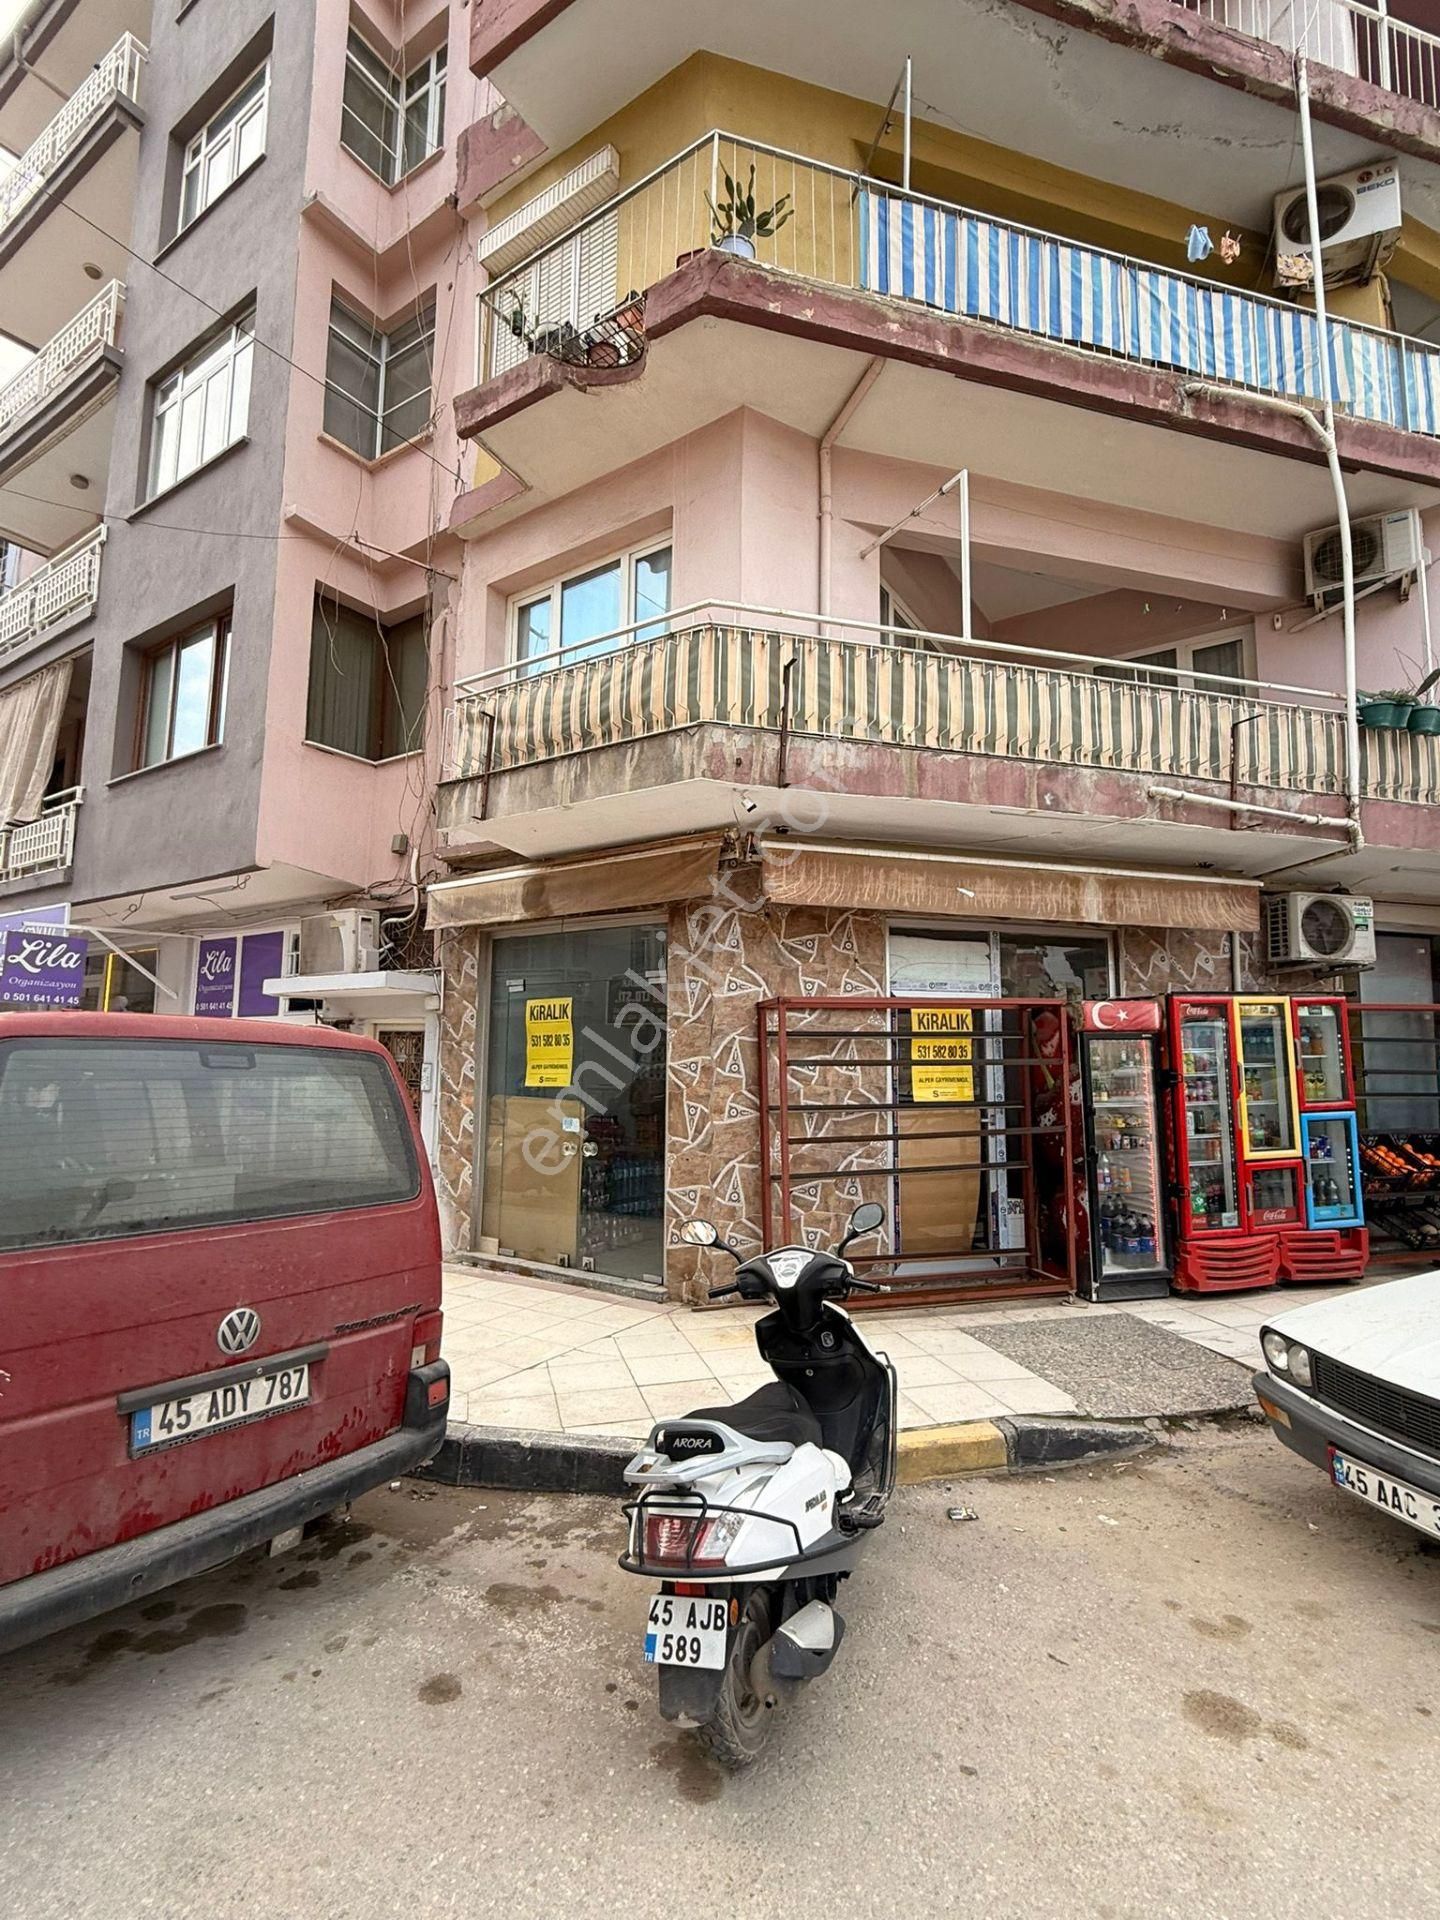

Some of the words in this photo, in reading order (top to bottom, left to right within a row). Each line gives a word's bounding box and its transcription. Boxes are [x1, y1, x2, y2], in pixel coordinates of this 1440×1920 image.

[1377, 166, 1392, 177] LG
[1357, 177, 1395, 194] BEKO
[8, 939, 81, 973] Lila
[200, 950, 232, 980] Lila
[9, 976, 77, 990] Organizasyon
[3, 992, 10, 1000] 0
[13, 992, 30, 1001] 501
[34, 994, 50, 1002] 641
[54, 995, 65, 1003] 41
[67, 996, 80, 1004] 45
[531, 1035, 541, 1047] 531
[543, 1035, 553, 1047] 582
[554, 1034, 561, 1046] 80
[562, 1034, 570, 1046] 35
[918, 1046, 931, 1058] 531
[933, 1046, 946, 1058] 582
[948, 1046, 957, 1058] 80
[958, 1046, 968, 1058] 35
[159, 1398, 191, 1434] 45
[207, 1381, 251, 1422] ADY
[265, 1367, 305, 1405] 787
[137, 1428, 150, 1440] TR
[673, 1437, 712, 1449] ARORA
[1345, 1466, 1368, 1495] 45
[1377, 1479, 1417, 1519] AAC
[649, 1600, 674, 1626] 45
[686, 1602, 726, 1631] AJB
[662, 1634, 701, 1663] 589
